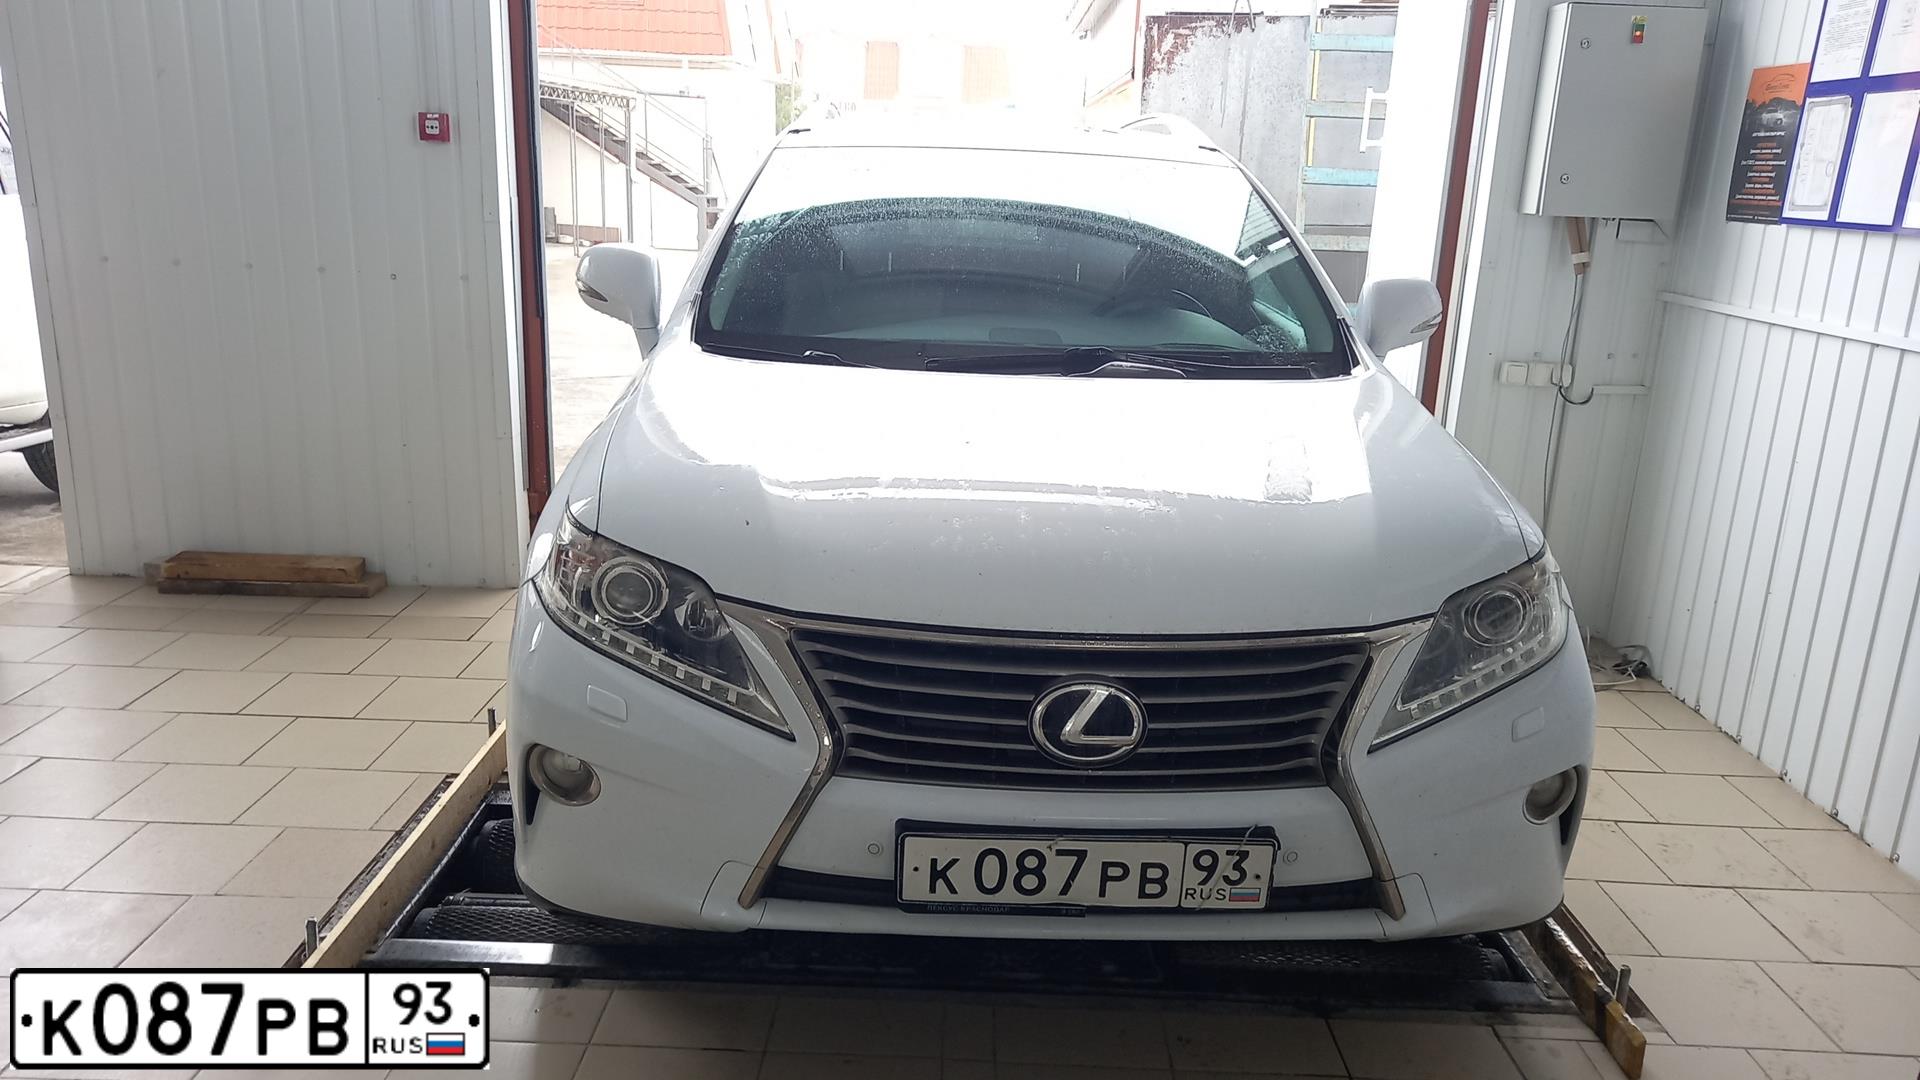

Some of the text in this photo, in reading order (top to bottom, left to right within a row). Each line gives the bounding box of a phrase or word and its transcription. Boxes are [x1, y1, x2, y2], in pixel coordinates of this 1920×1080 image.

[927, 848, 1250, 901] К087РВ 93
[1184, 888, 1227, 901] RUS
